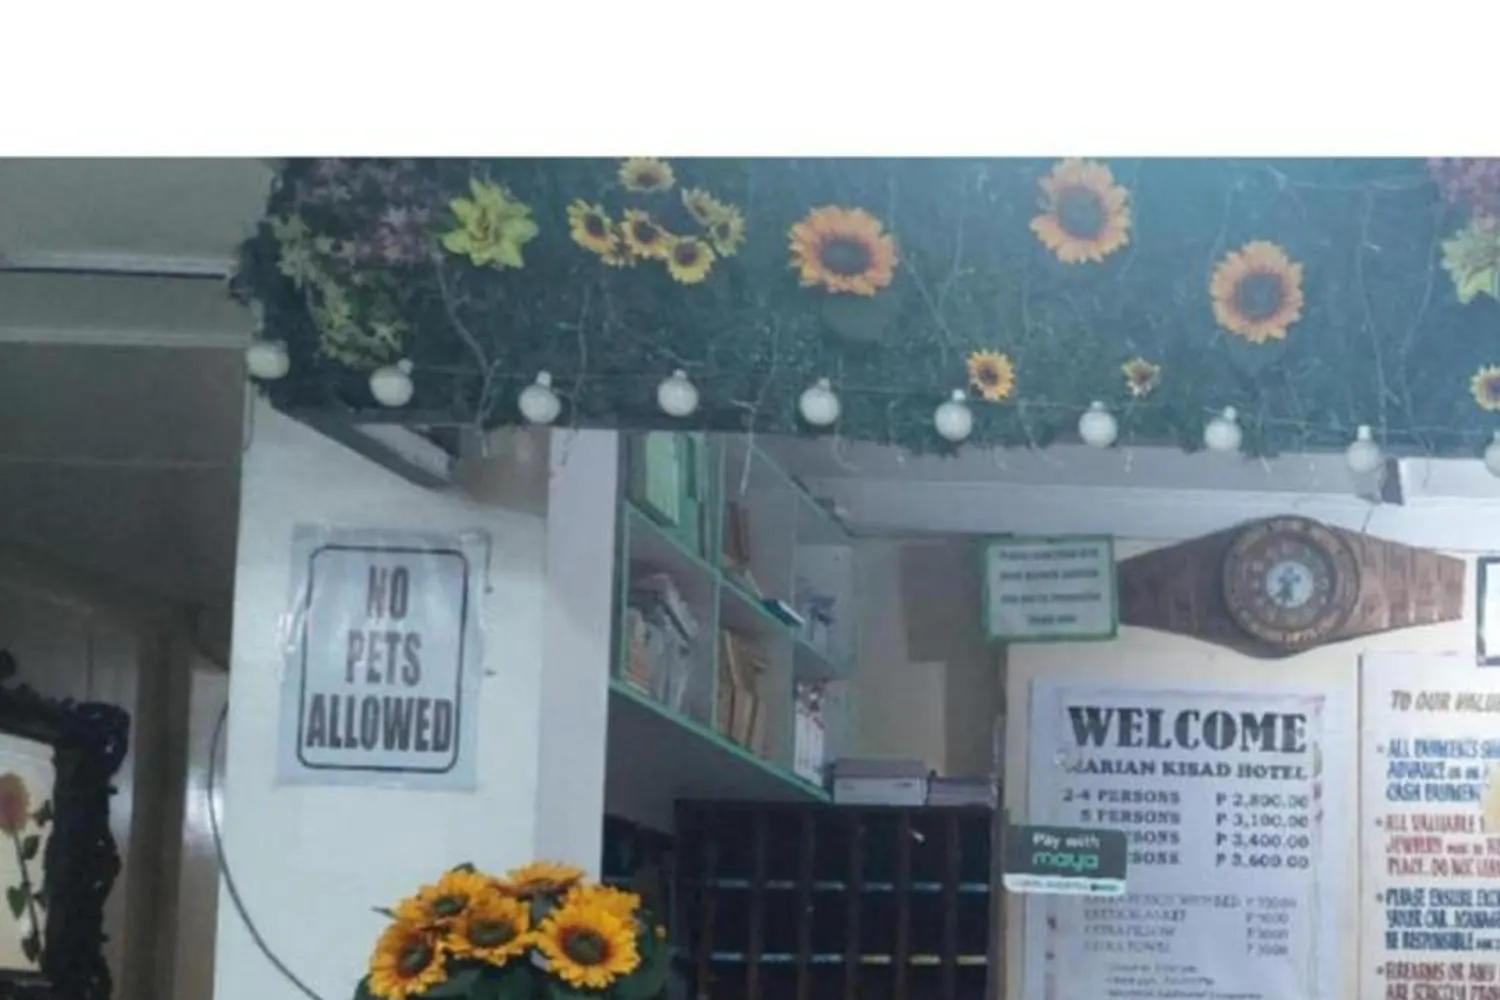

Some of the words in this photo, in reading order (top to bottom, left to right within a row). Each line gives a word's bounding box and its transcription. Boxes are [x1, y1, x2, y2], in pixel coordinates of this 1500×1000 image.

[368, 564, 409, 620] NO
[345, 630, 422, 686] PETS
[1391, 690, 1412, 711] TO
[1415, 690, 1451, 711] OUR
[306, 694, 452, 753] ALLOWED
[1068, 706, 1306, 753] WELCOME
[1237, 764, 1306, 781] HOTEL
[1062, 789, 1089, 802] 2-4
[1098, 790, 1180, 804] PERSONS
[1386, 783, 1420, 801] CASH
[1080, 808, 1091, 822] 5
[1098, 809, 1180, 824] PERSONS
[1411, 815, 1474, 834] VALUABLE
[1032, 832, 1061, 850] Pay
[1065, 833, 1099, 848] with
[1231, 833, 1310, 849] 3,400.00
[1032, 852, 1099, 871] maya
[1231, 853, 1310, 869] 3,600.00
[1431, 859, 1448, 876] DO
[1386, 888, 1425, 906] PLEASE
[1402, 932, 1473, 951] RESPONSIBLE
[1386, 963, 1445, 981] FIREARMS
[1469, 963, 1495, 981] ANY
[1385, 984, 1408, 1000] ARE
